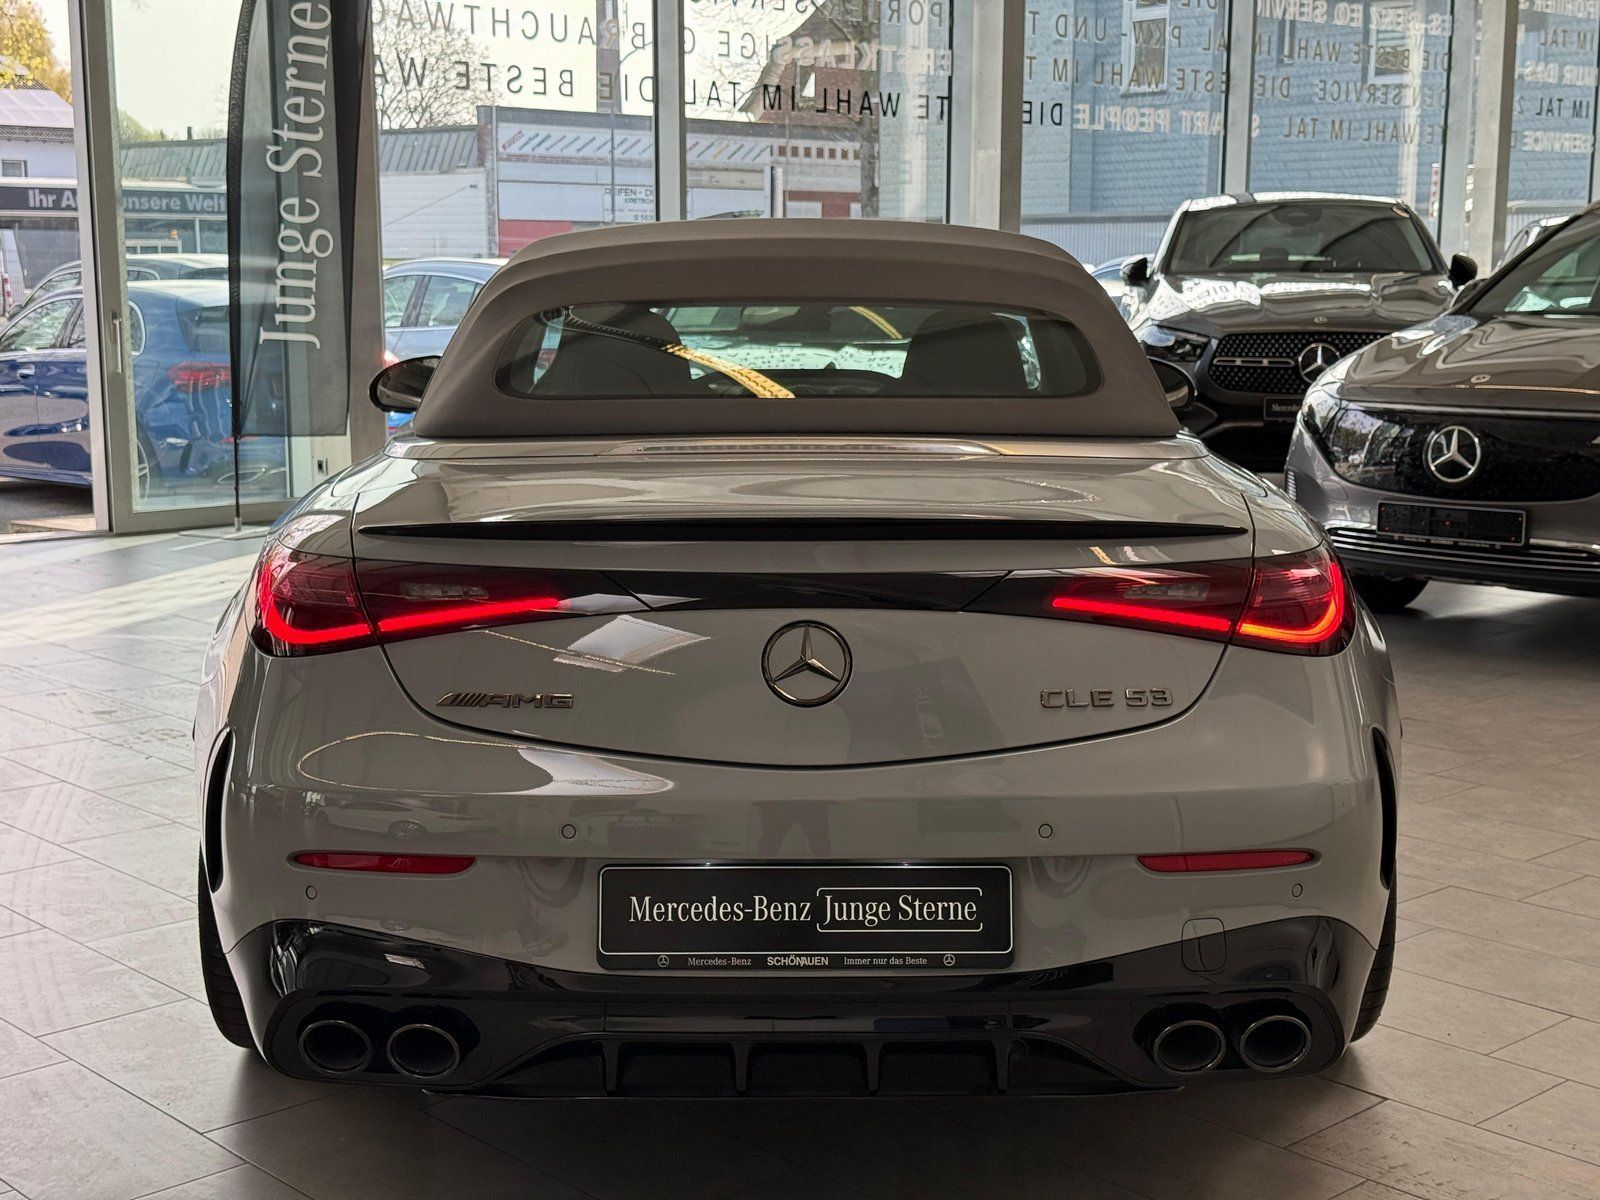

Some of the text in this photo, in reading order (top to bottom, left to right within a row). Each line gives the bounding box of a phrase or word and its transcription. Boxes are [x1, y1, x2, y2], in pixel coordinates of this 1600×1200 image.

[259, 0, 333, 349] Junge Sterne
[28, 188, 56, 208] Ihr
[61, 189, 78, 208] A
[481, 693, 574, 709] AMG
[1040, 687, 1173, 708] CLE 53
[629, 894, 977, 927] Mercedes-Benz Junge Sterne
[688, 957, 752, 967] Mercedes-Benz
[843, 957, 871, 966] Immer
[873, 958, 888, 966] nur
[889, 957, 904, 966] das
[905, 957, 927, 966] Beste
